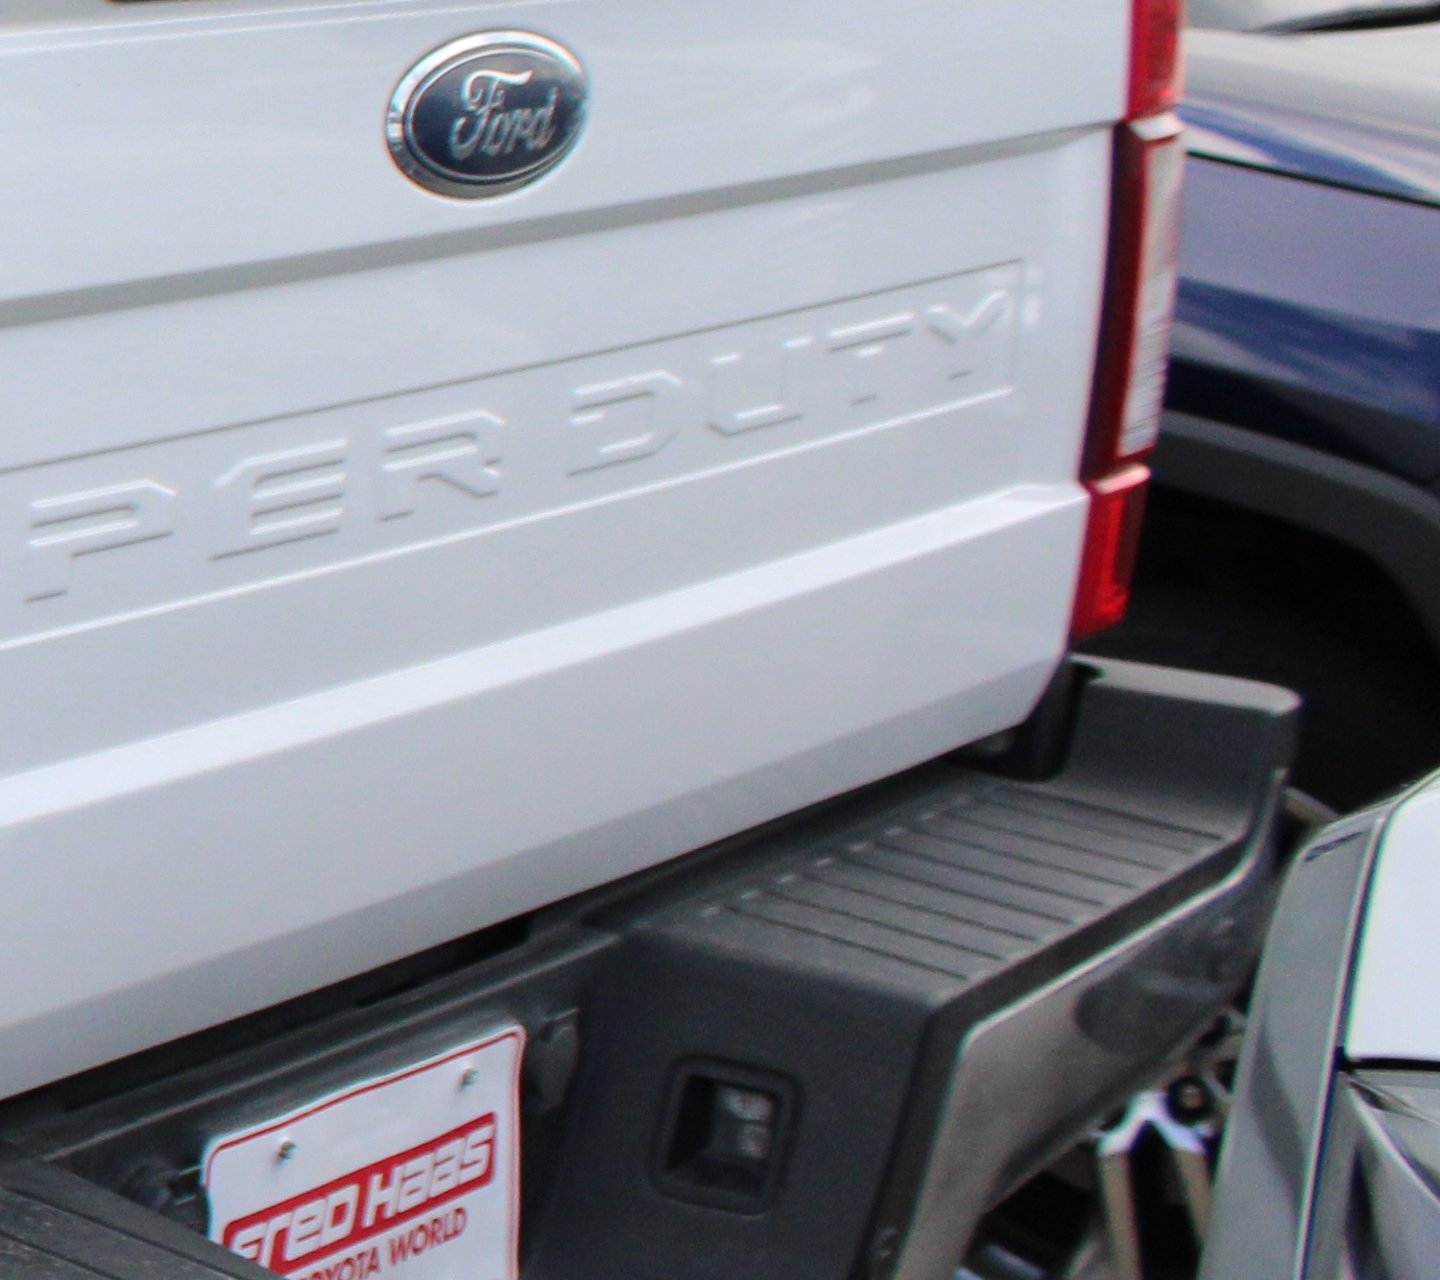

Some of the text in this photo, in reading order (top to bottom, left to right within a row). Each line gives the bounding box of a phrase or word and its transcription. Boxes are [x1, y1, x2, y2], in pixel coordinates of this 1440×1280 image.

[449, 70, 558, 160] Ford
[569, 287, 1011, 476] DUTY
[388, 1208, 468, 1265] WORLD
